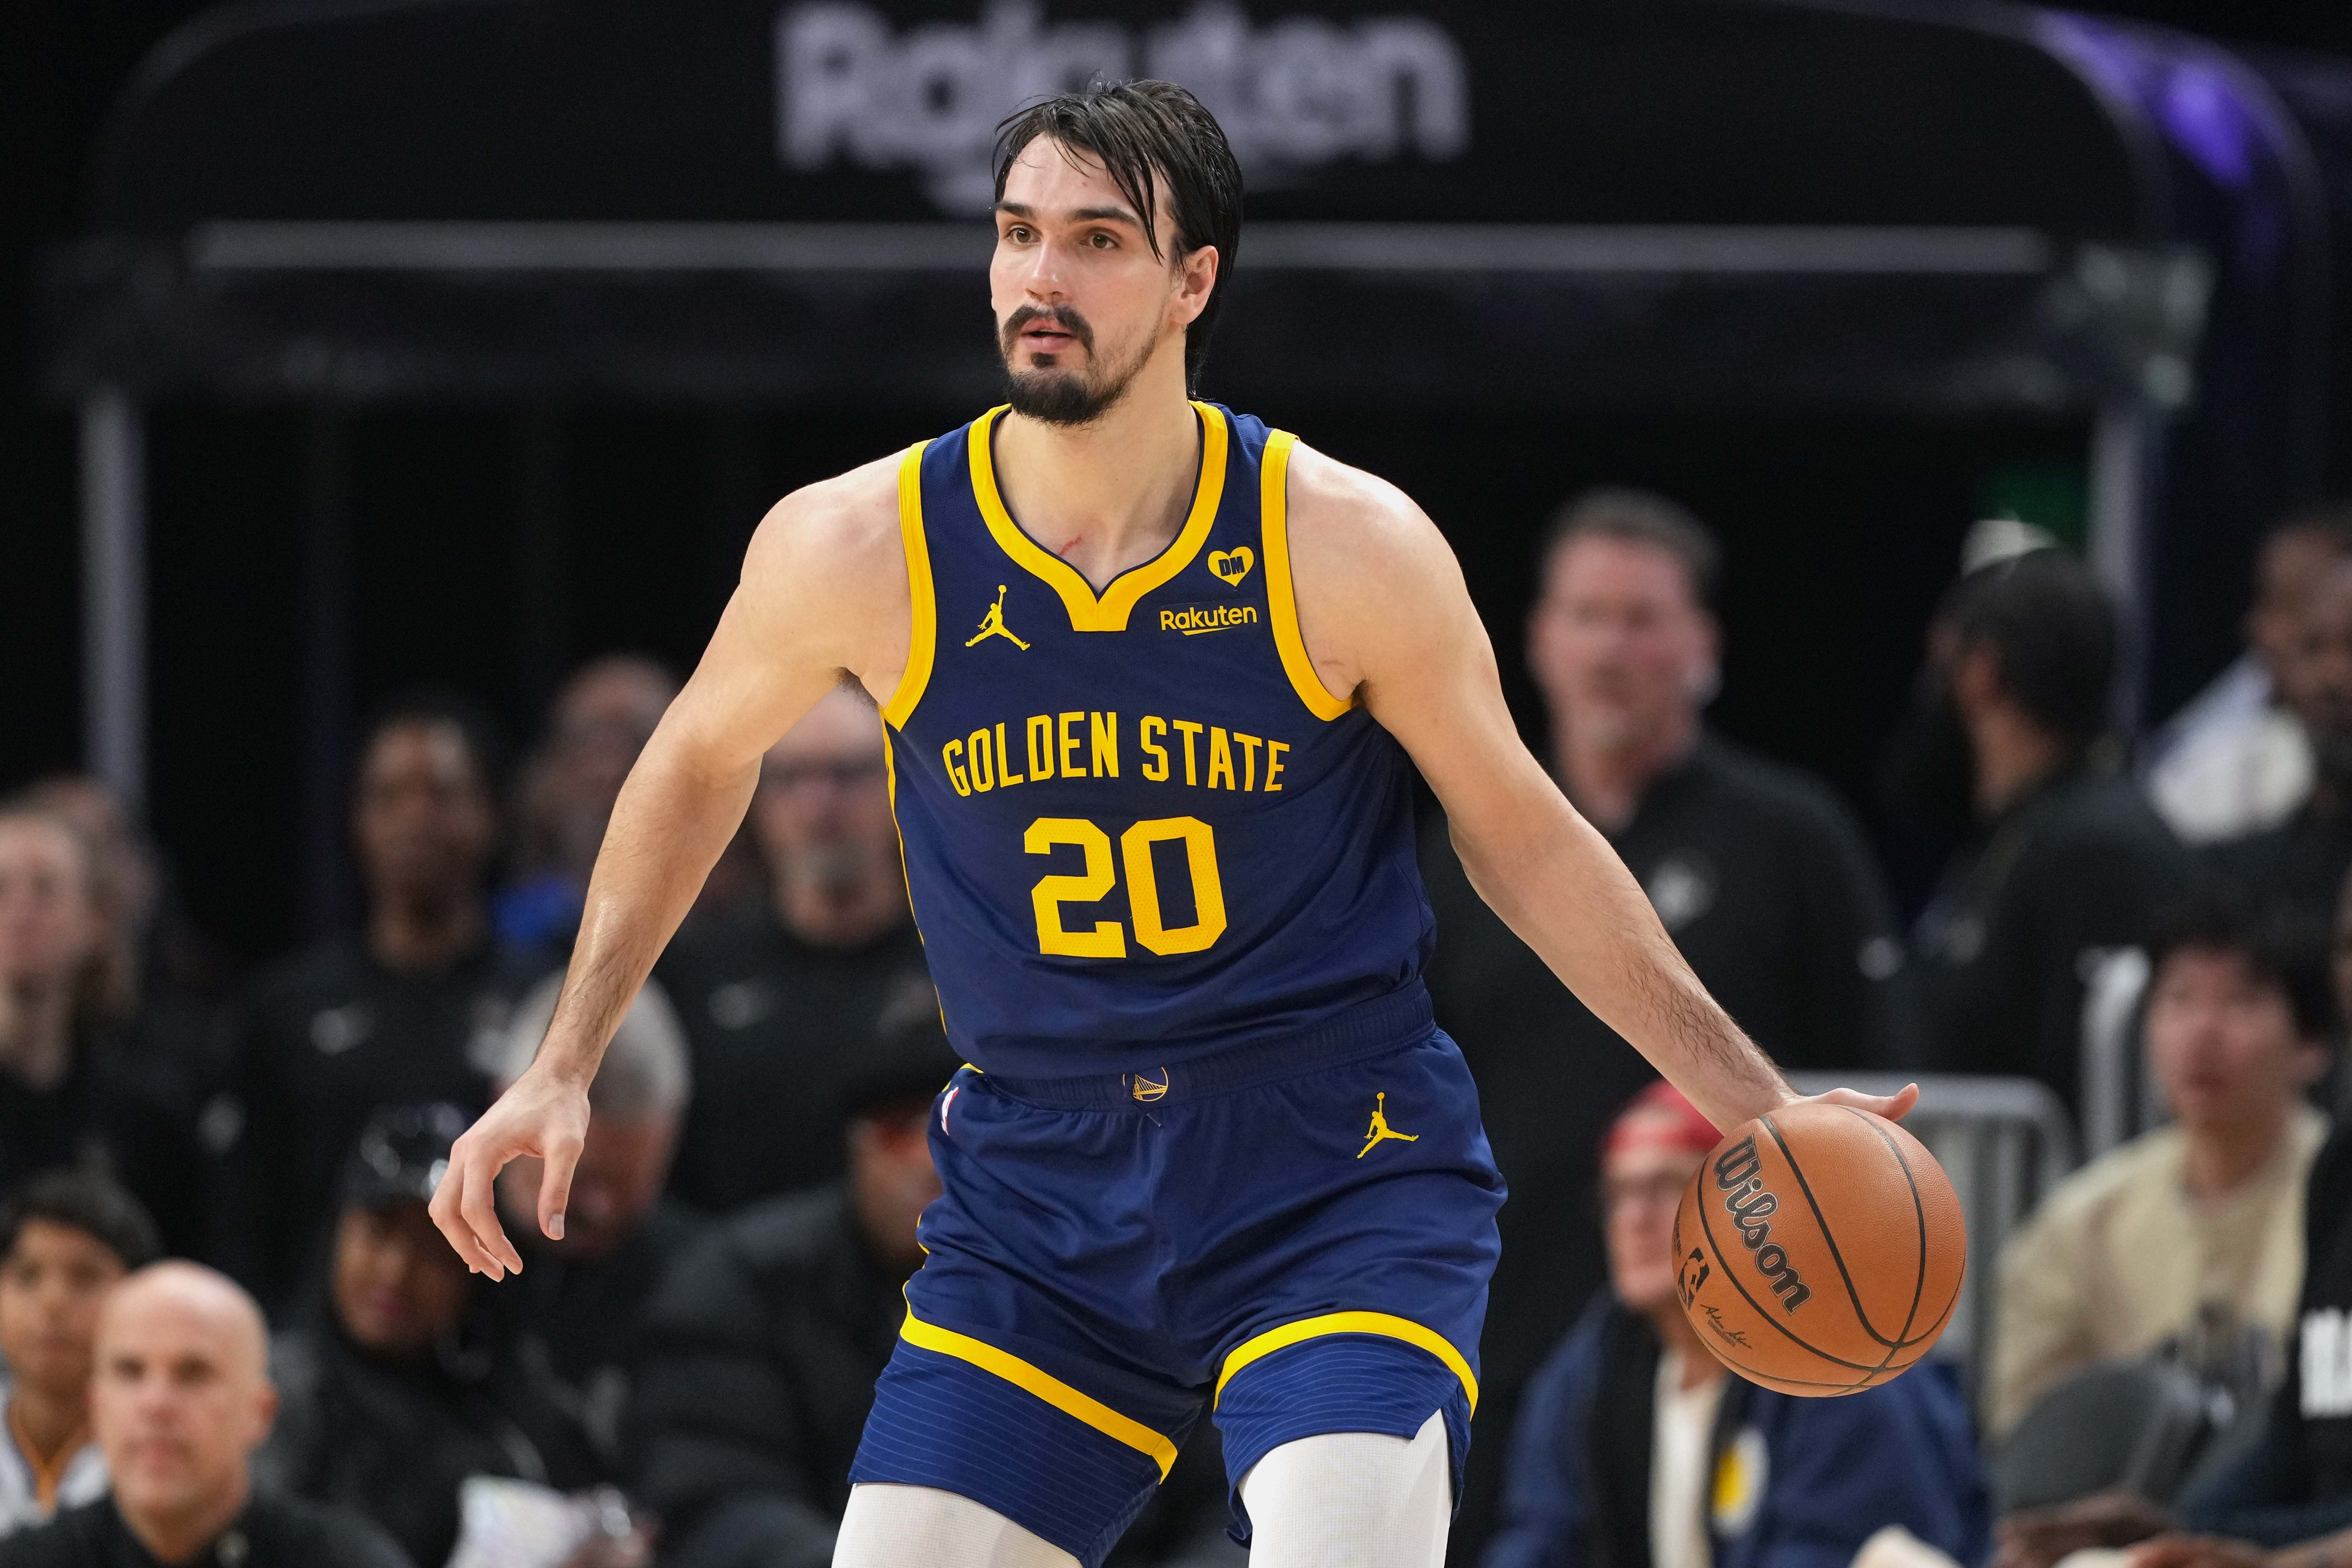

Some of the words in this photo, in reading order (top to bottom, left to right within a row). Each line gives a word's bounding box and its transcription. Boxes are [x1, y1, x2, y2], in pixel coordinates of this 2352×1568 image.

[1218, 555, 1245, 576] DM
[1160, 605, 1257, 631] Rakuten
[942, 711, 1119, 796] GOLDEN
[1140, 716, 1289, 791] STATE
[1024, 816, 1227, 958] 20
[1713, 1133, 1812, 1316] Wilson
